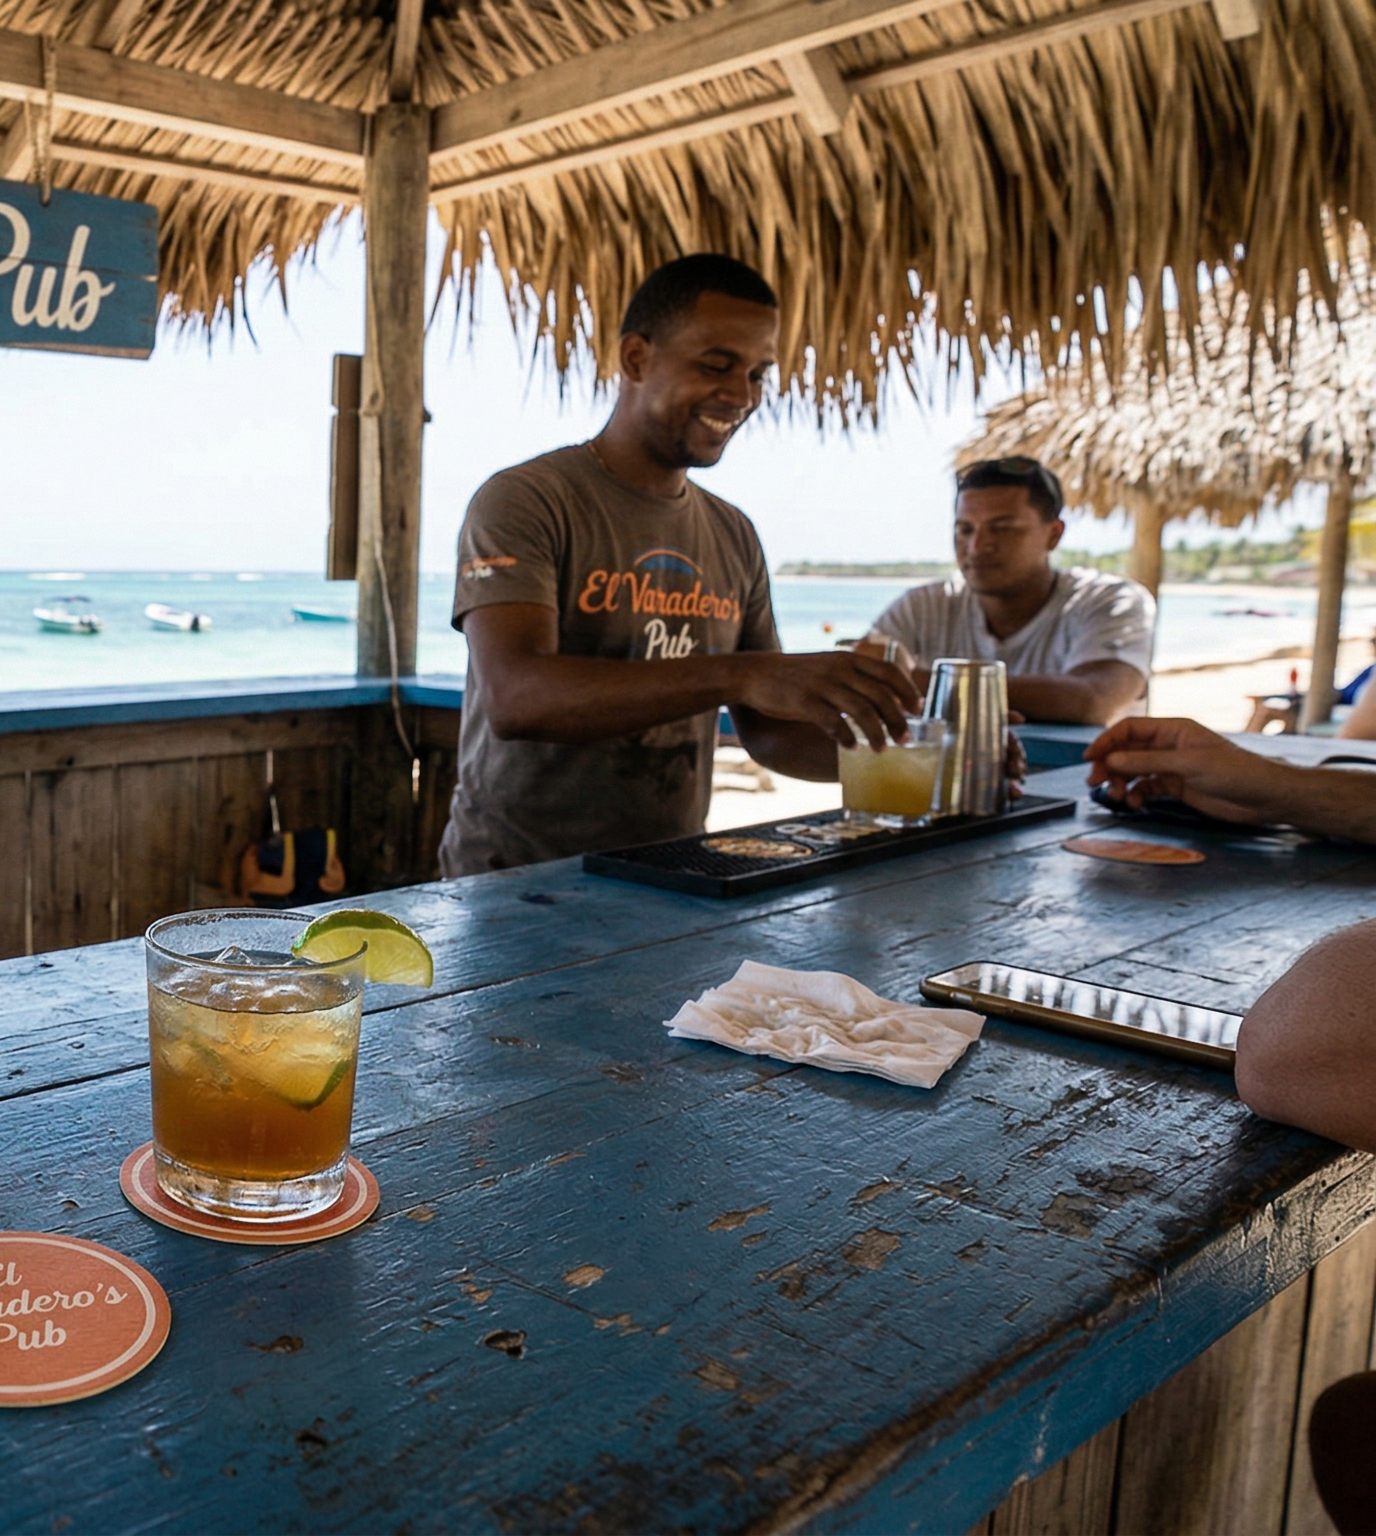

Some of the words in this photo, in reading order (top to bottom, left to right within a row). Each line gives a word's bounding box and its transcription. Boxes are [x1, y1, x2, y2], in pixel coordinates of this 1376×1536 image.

[578, 569, 620, 614] El
[623, 571, 742, 623] Varadero's
[644, 618, 699, 660] Pub
